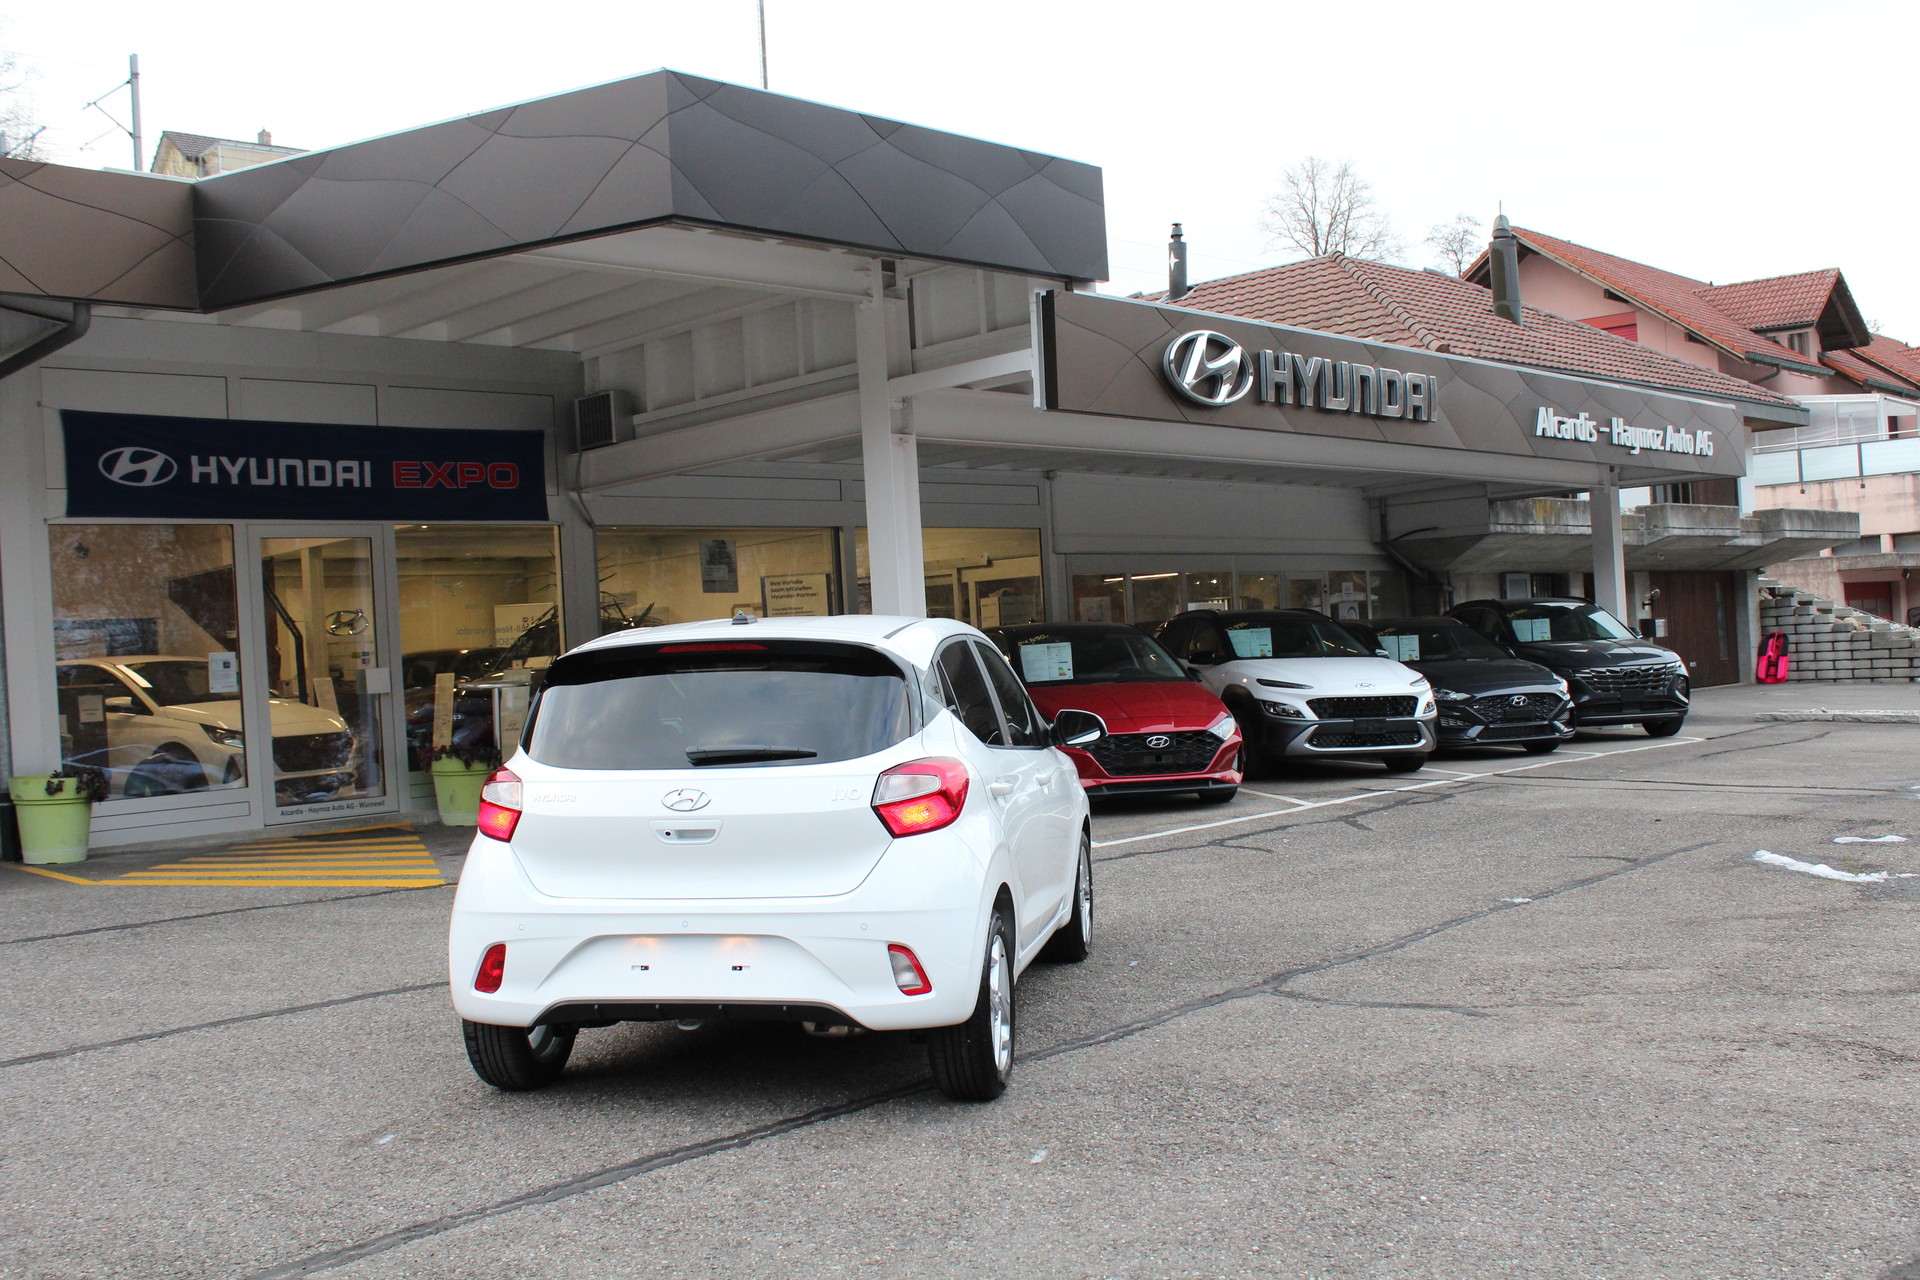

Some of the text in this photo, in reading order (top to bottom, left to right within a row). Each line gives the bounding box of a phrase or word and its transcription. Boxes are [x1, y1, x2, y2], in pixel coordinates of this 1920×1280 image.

[1259, 349, 1438, 423] HYUNDAI
[1535, 406, 1598, 443] Alcardis
[1610, 416, 1665, 455] Haymoz
[1664, 425, 1694, 455] Auto
[1694, 429, 1714, 456] AG
[190, 455, 520, 490] HYUNDAI EXPO
[280, 809, 304, 817] Alcardis
[308, 806, 331, 815] Haymoz
